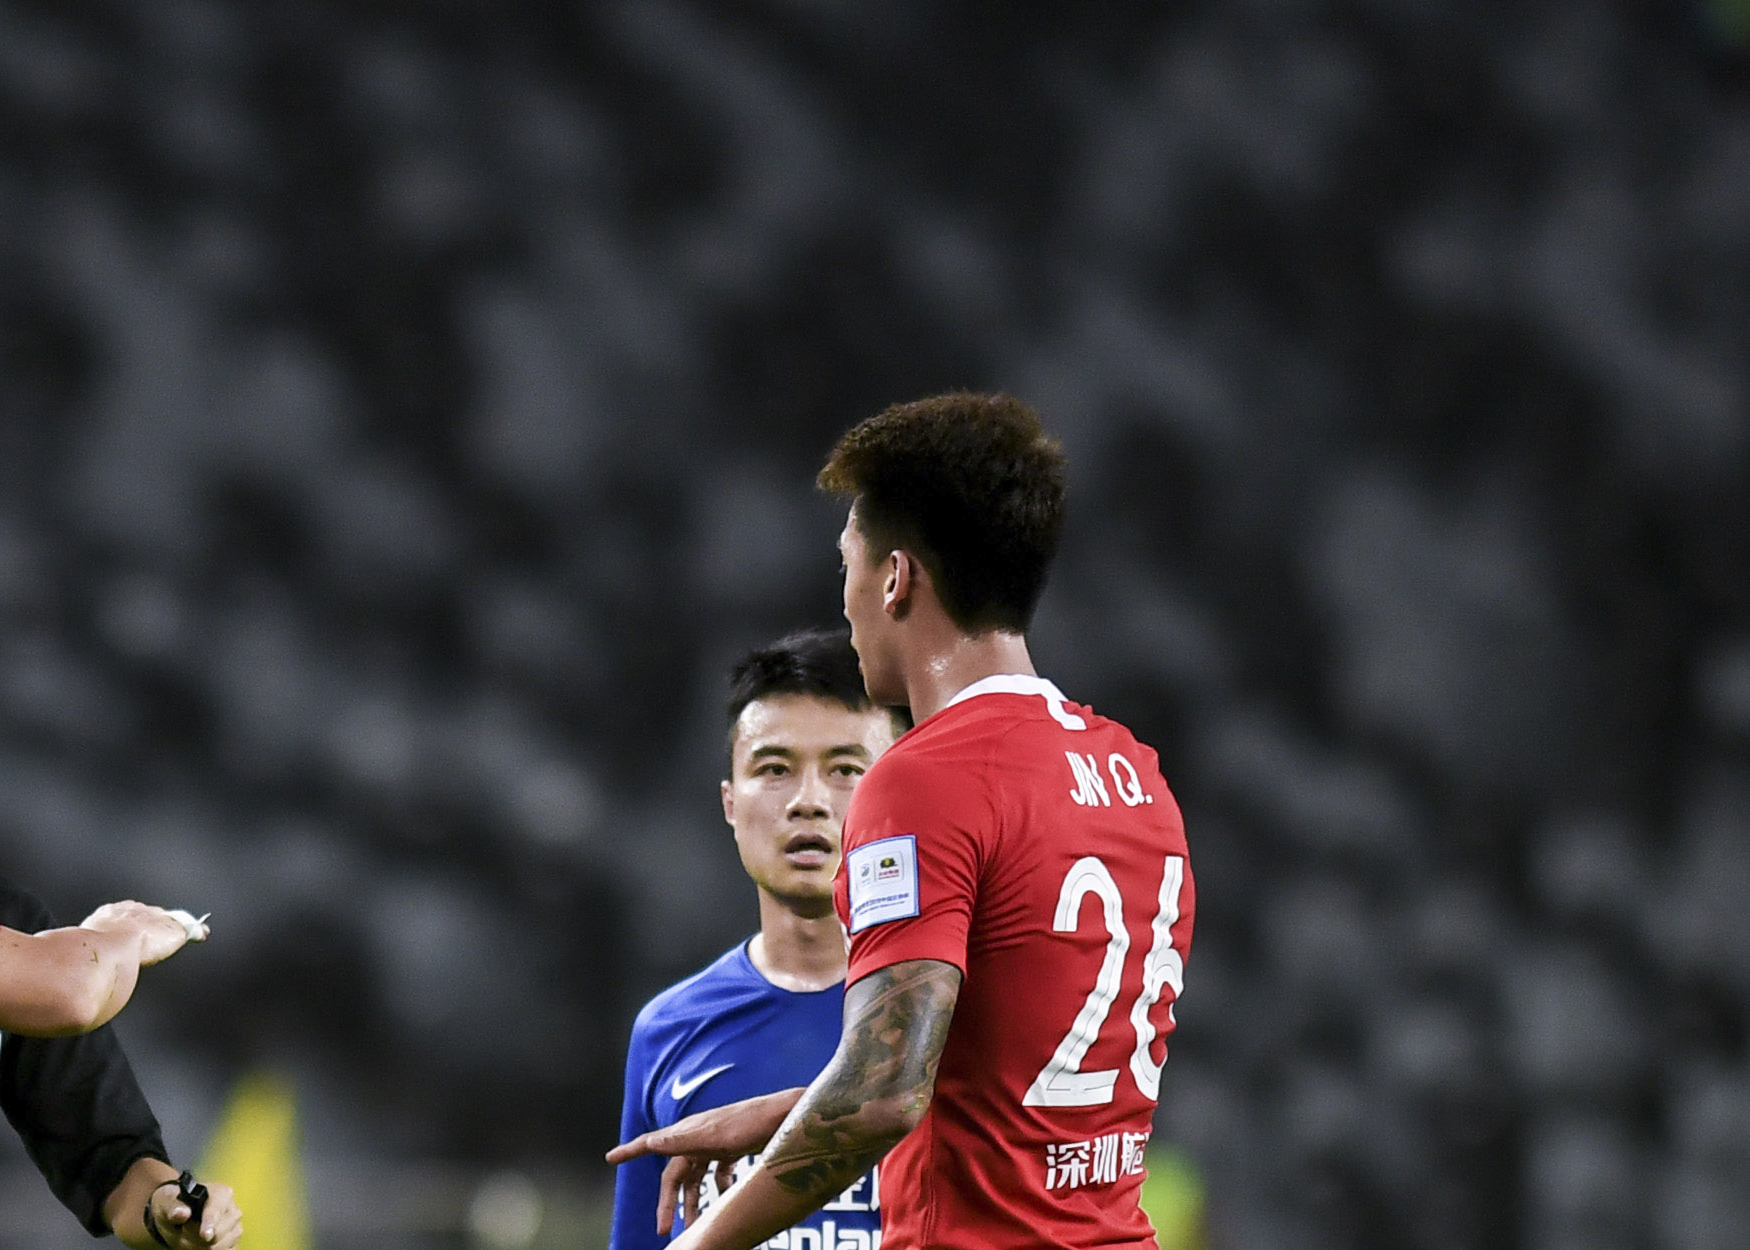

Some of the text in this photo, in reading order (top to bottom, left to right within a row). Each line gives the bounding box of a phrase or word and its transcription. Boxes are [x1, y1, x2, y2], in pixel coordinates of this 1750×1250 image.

[1107, 751, 1154, 808] Q.
[1022, 855, 1185, 1106] 26
[1045, 1131, 1150, 1191] 深圳航
